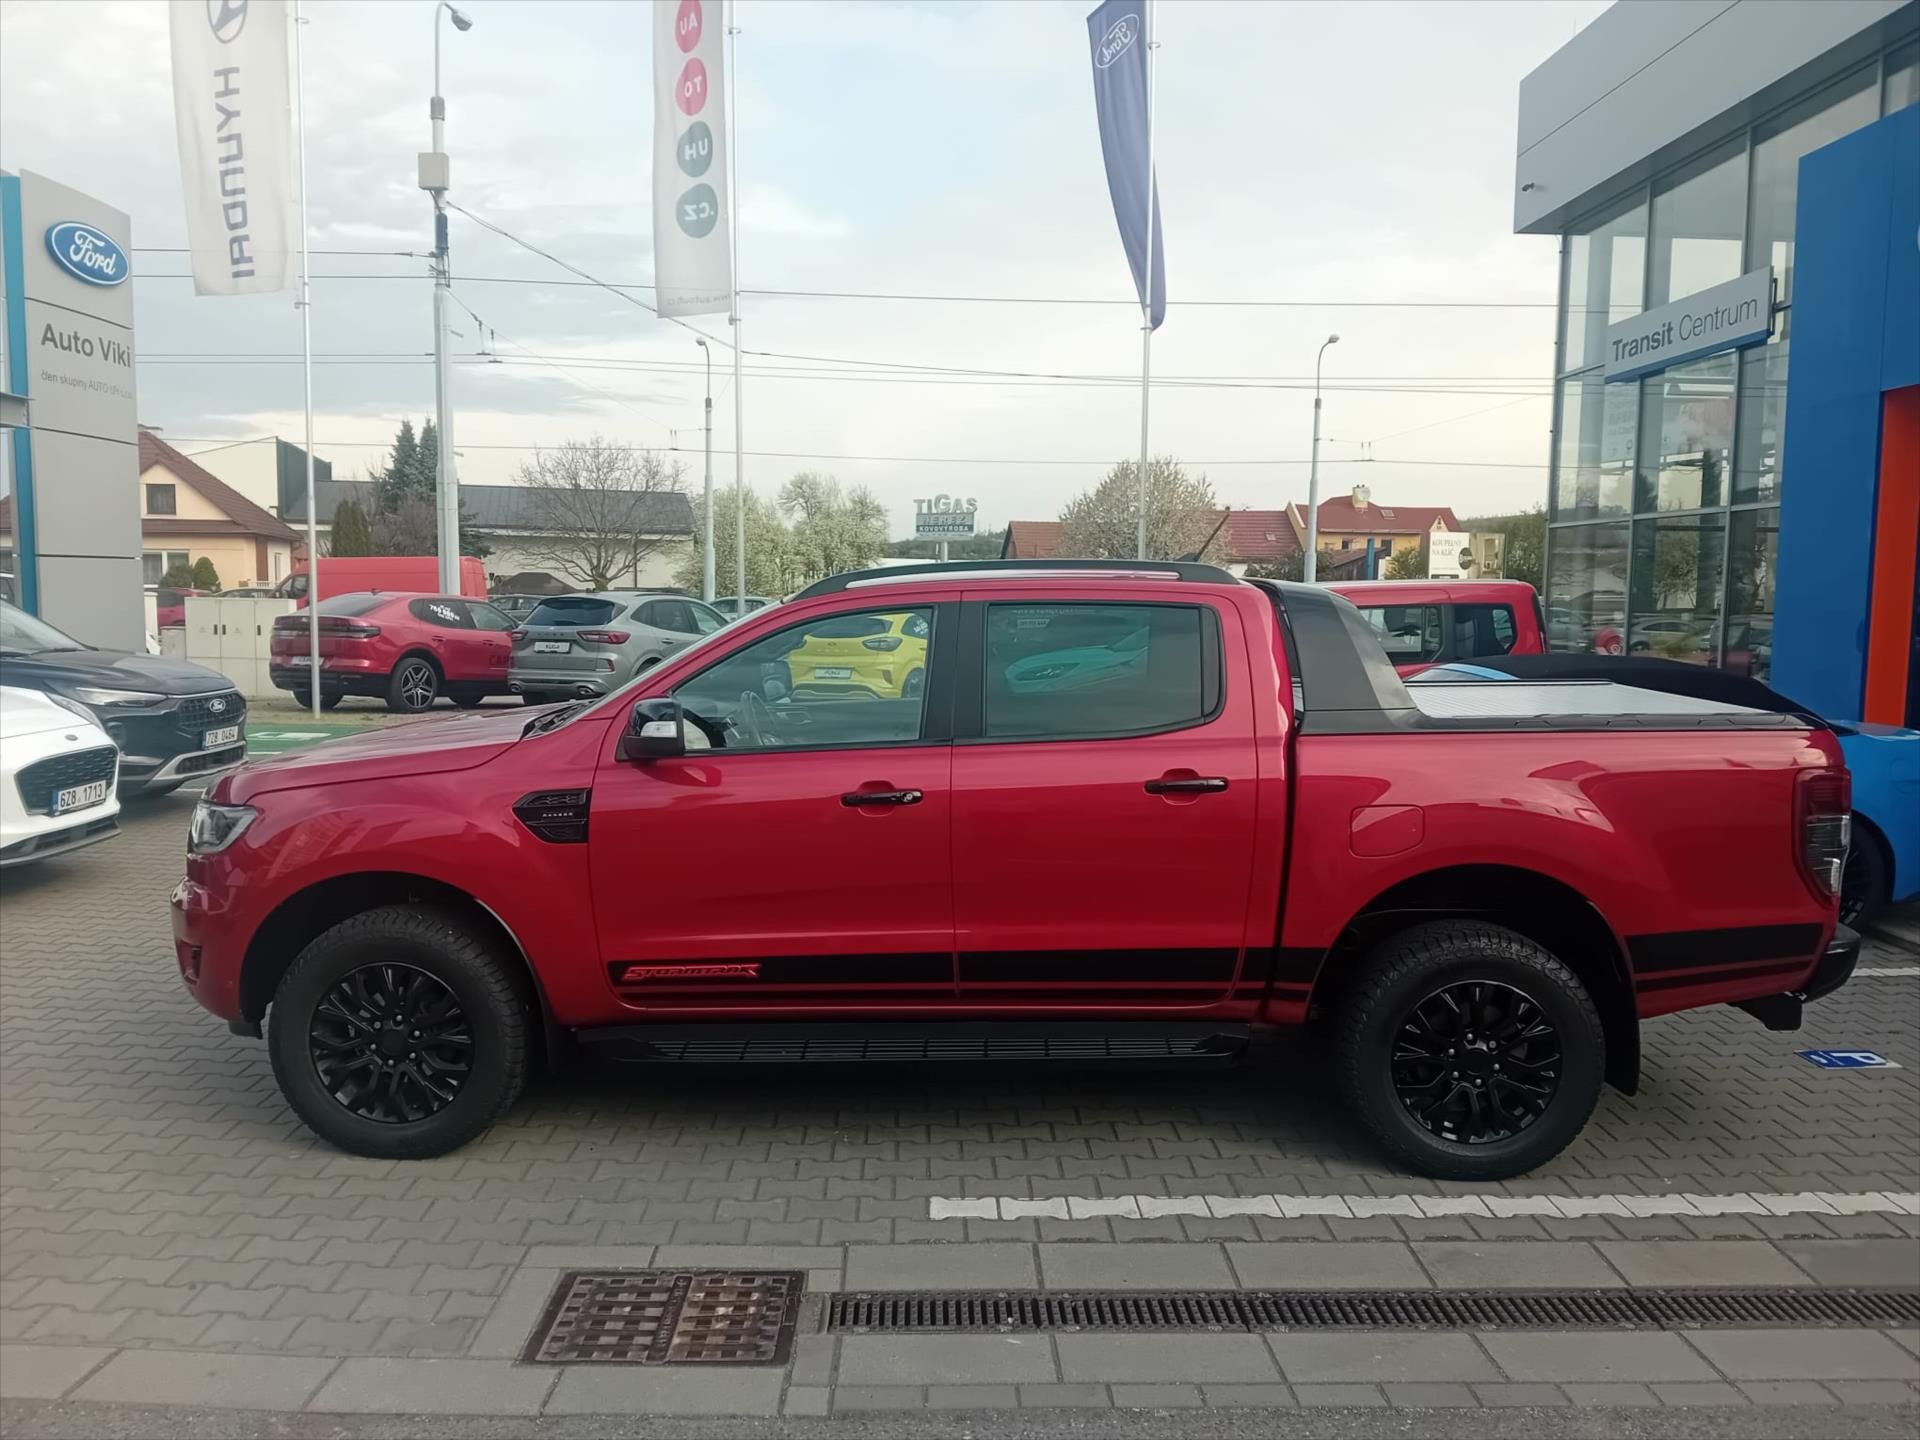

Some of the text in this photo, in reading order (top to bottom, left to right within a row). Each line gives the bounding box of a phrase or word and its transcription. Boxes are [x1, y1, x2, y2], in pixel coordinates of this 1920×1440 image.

[69, 230, 117, 276] Ford
[41, 323, 132, 368] Auto Viki
[1612, 298, 1758, 362] Transit Centrum
[913, 493, 978, 514] TIGAS
[84, 783, 103, 801] 1713
